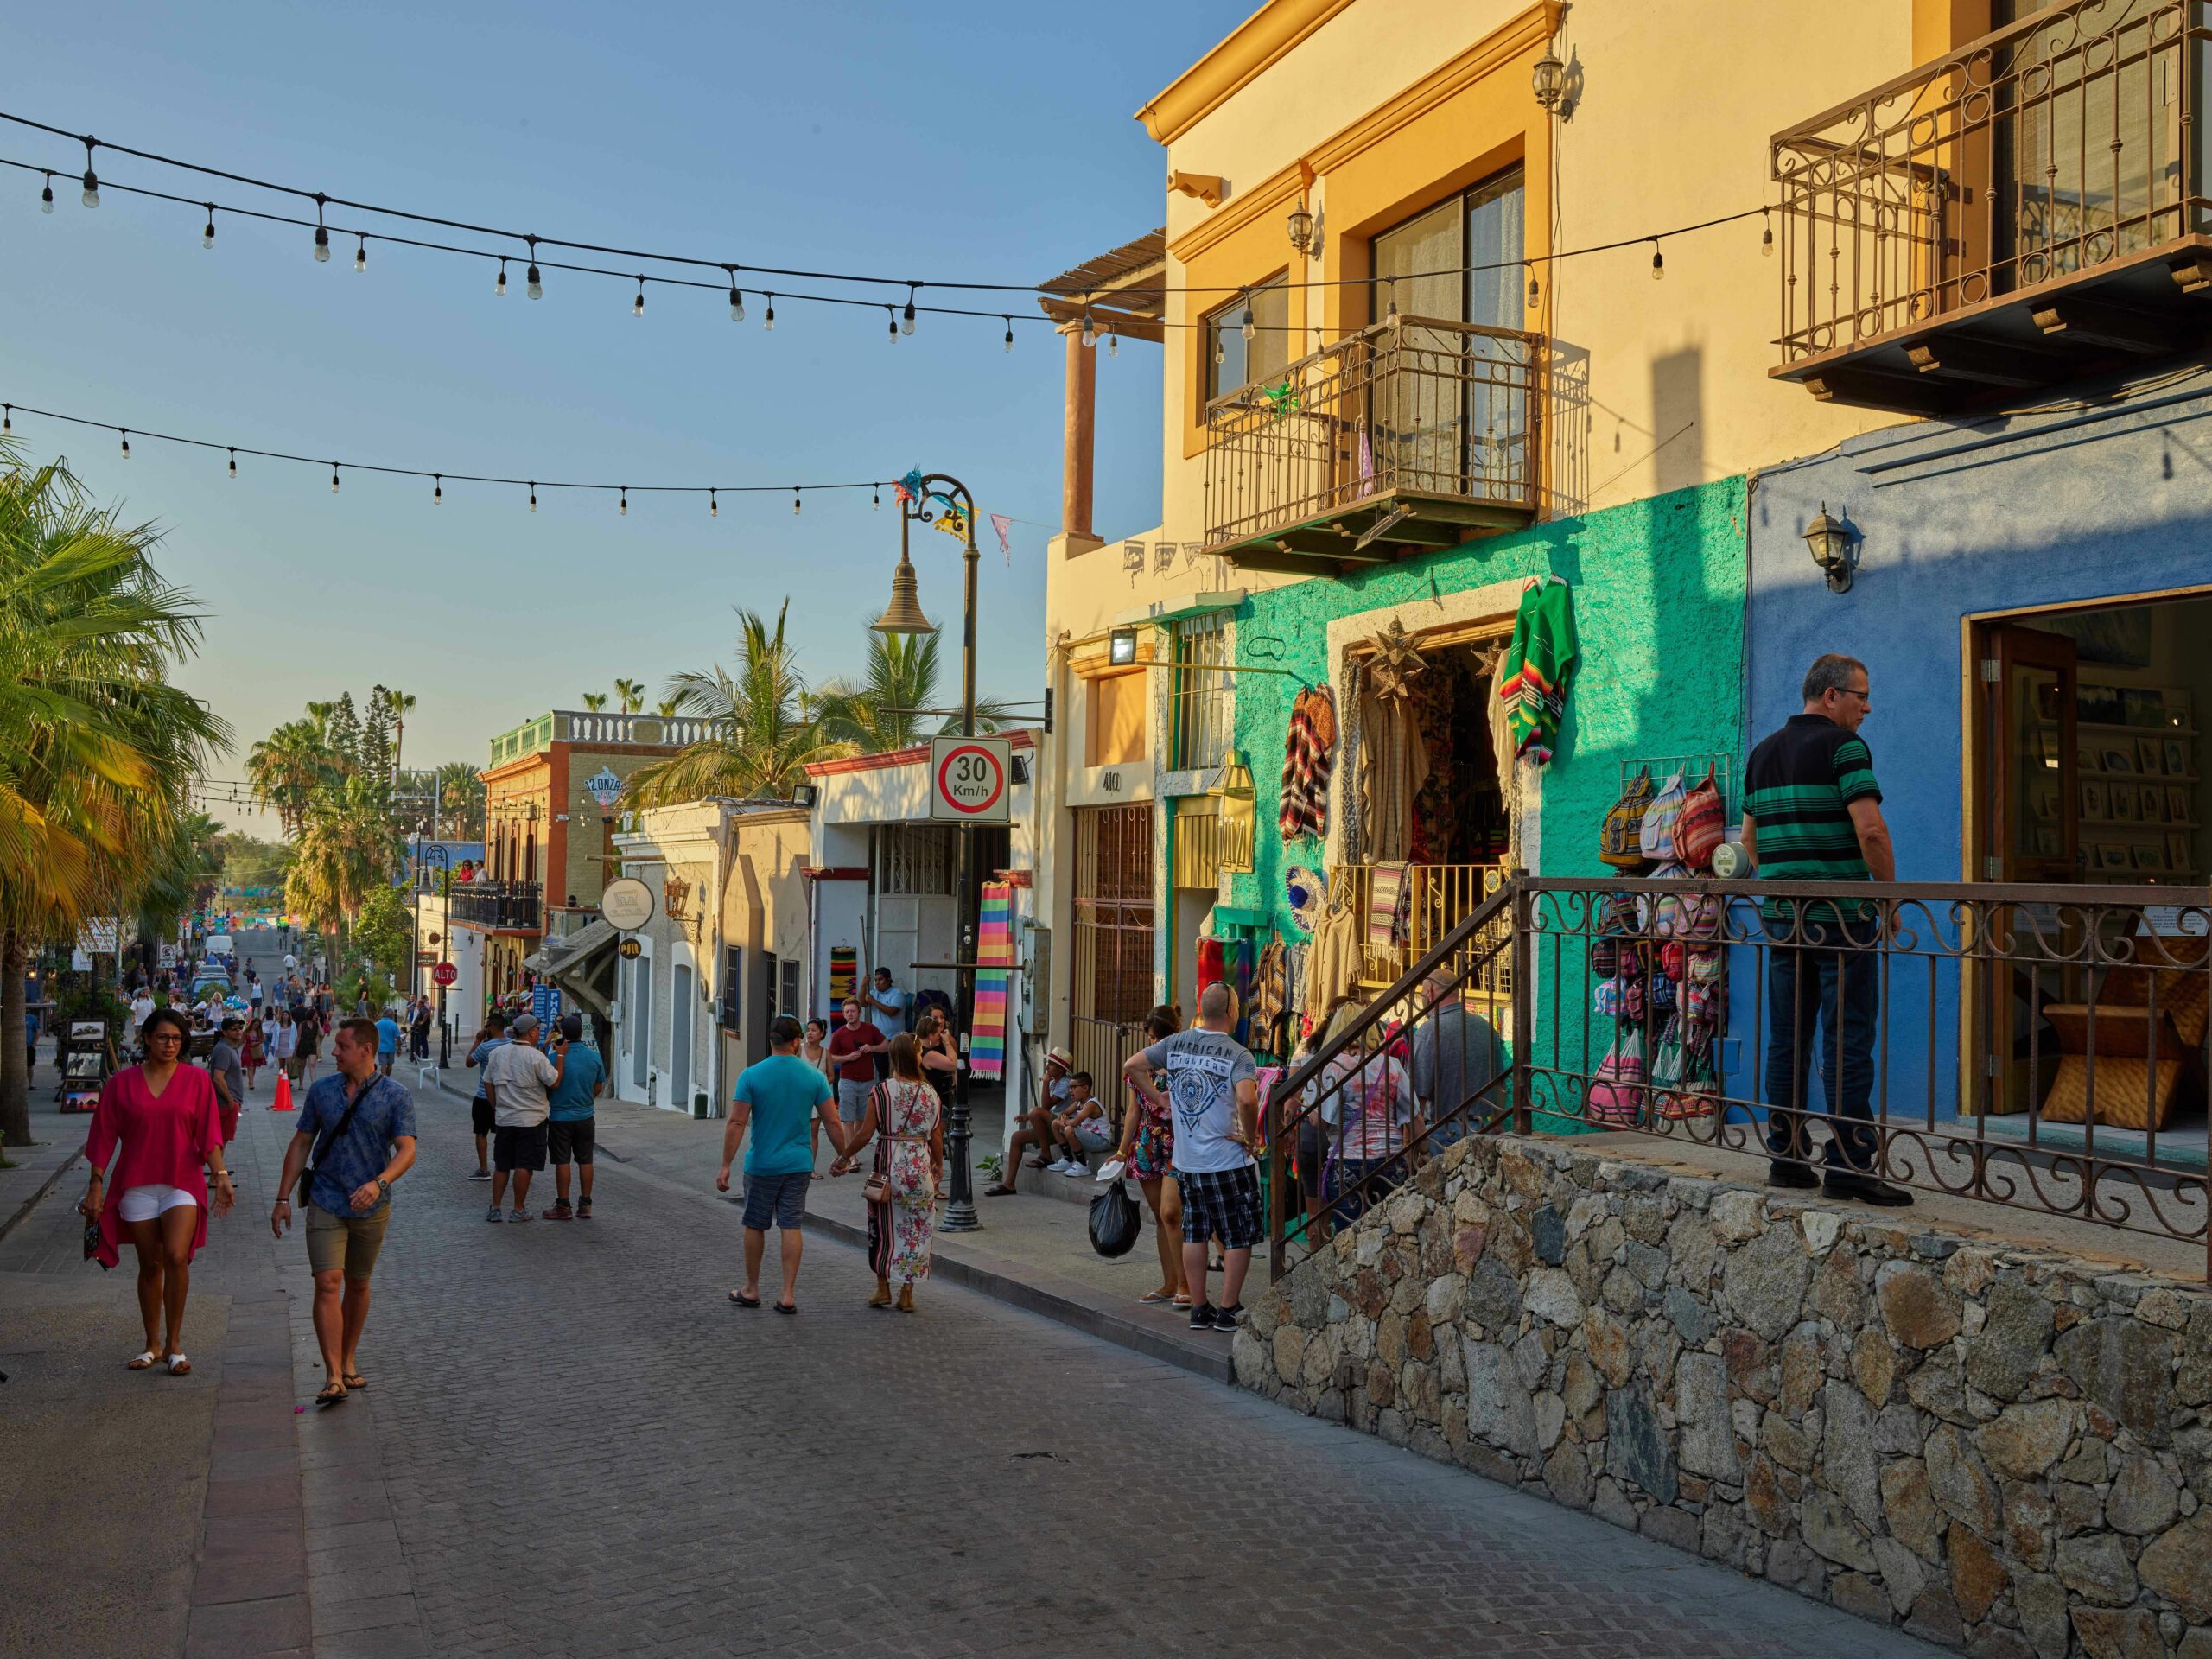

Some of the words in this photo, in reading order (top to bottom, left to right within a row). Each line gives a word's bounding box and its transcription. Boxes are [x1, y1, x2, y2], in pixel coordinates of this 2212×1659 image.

[957, 755, 987, 782] 30
[584, 779, 596, 792] 12
[953, 785, 988, 797] Km/h
[434, 969, 456, 980] ALTO
[1172, 1040, 1233, 1058] AMERICAN
